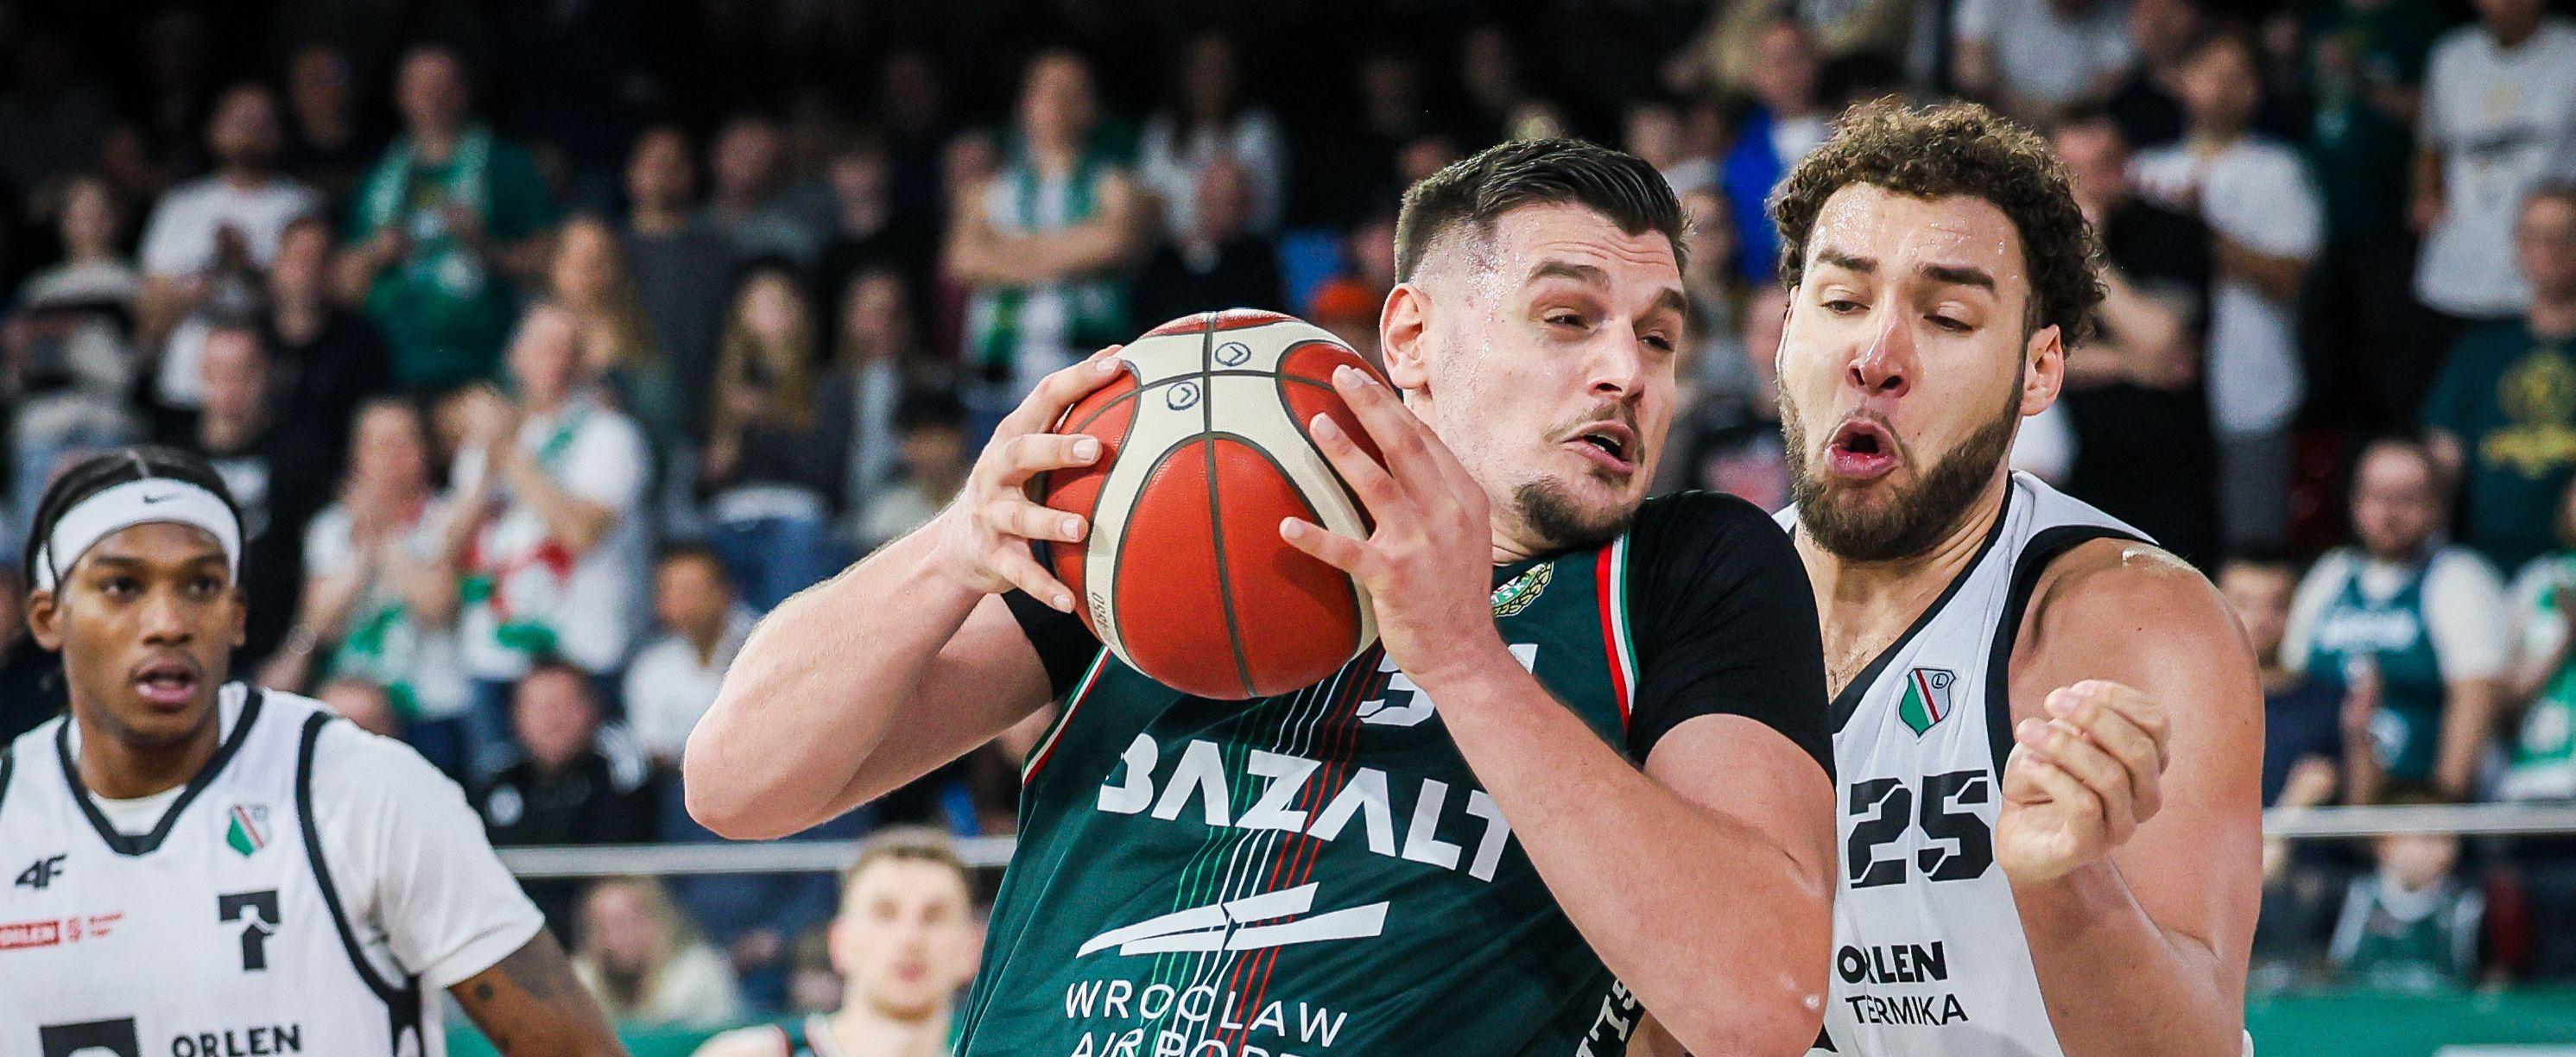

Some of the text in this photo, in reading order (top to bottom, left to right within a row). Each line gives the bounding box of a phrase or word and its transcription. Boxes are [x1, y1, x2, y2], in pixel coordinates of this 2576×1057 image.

[1848, 769, 1994, 889] 25
[15, 851, 67, 889] 4F
[1066, 979, 1347, 1048] WROCLAW
[1845, 993, 1969, 1026] TERMIKA
[171, 1023, 302, 1057] ORLEN
